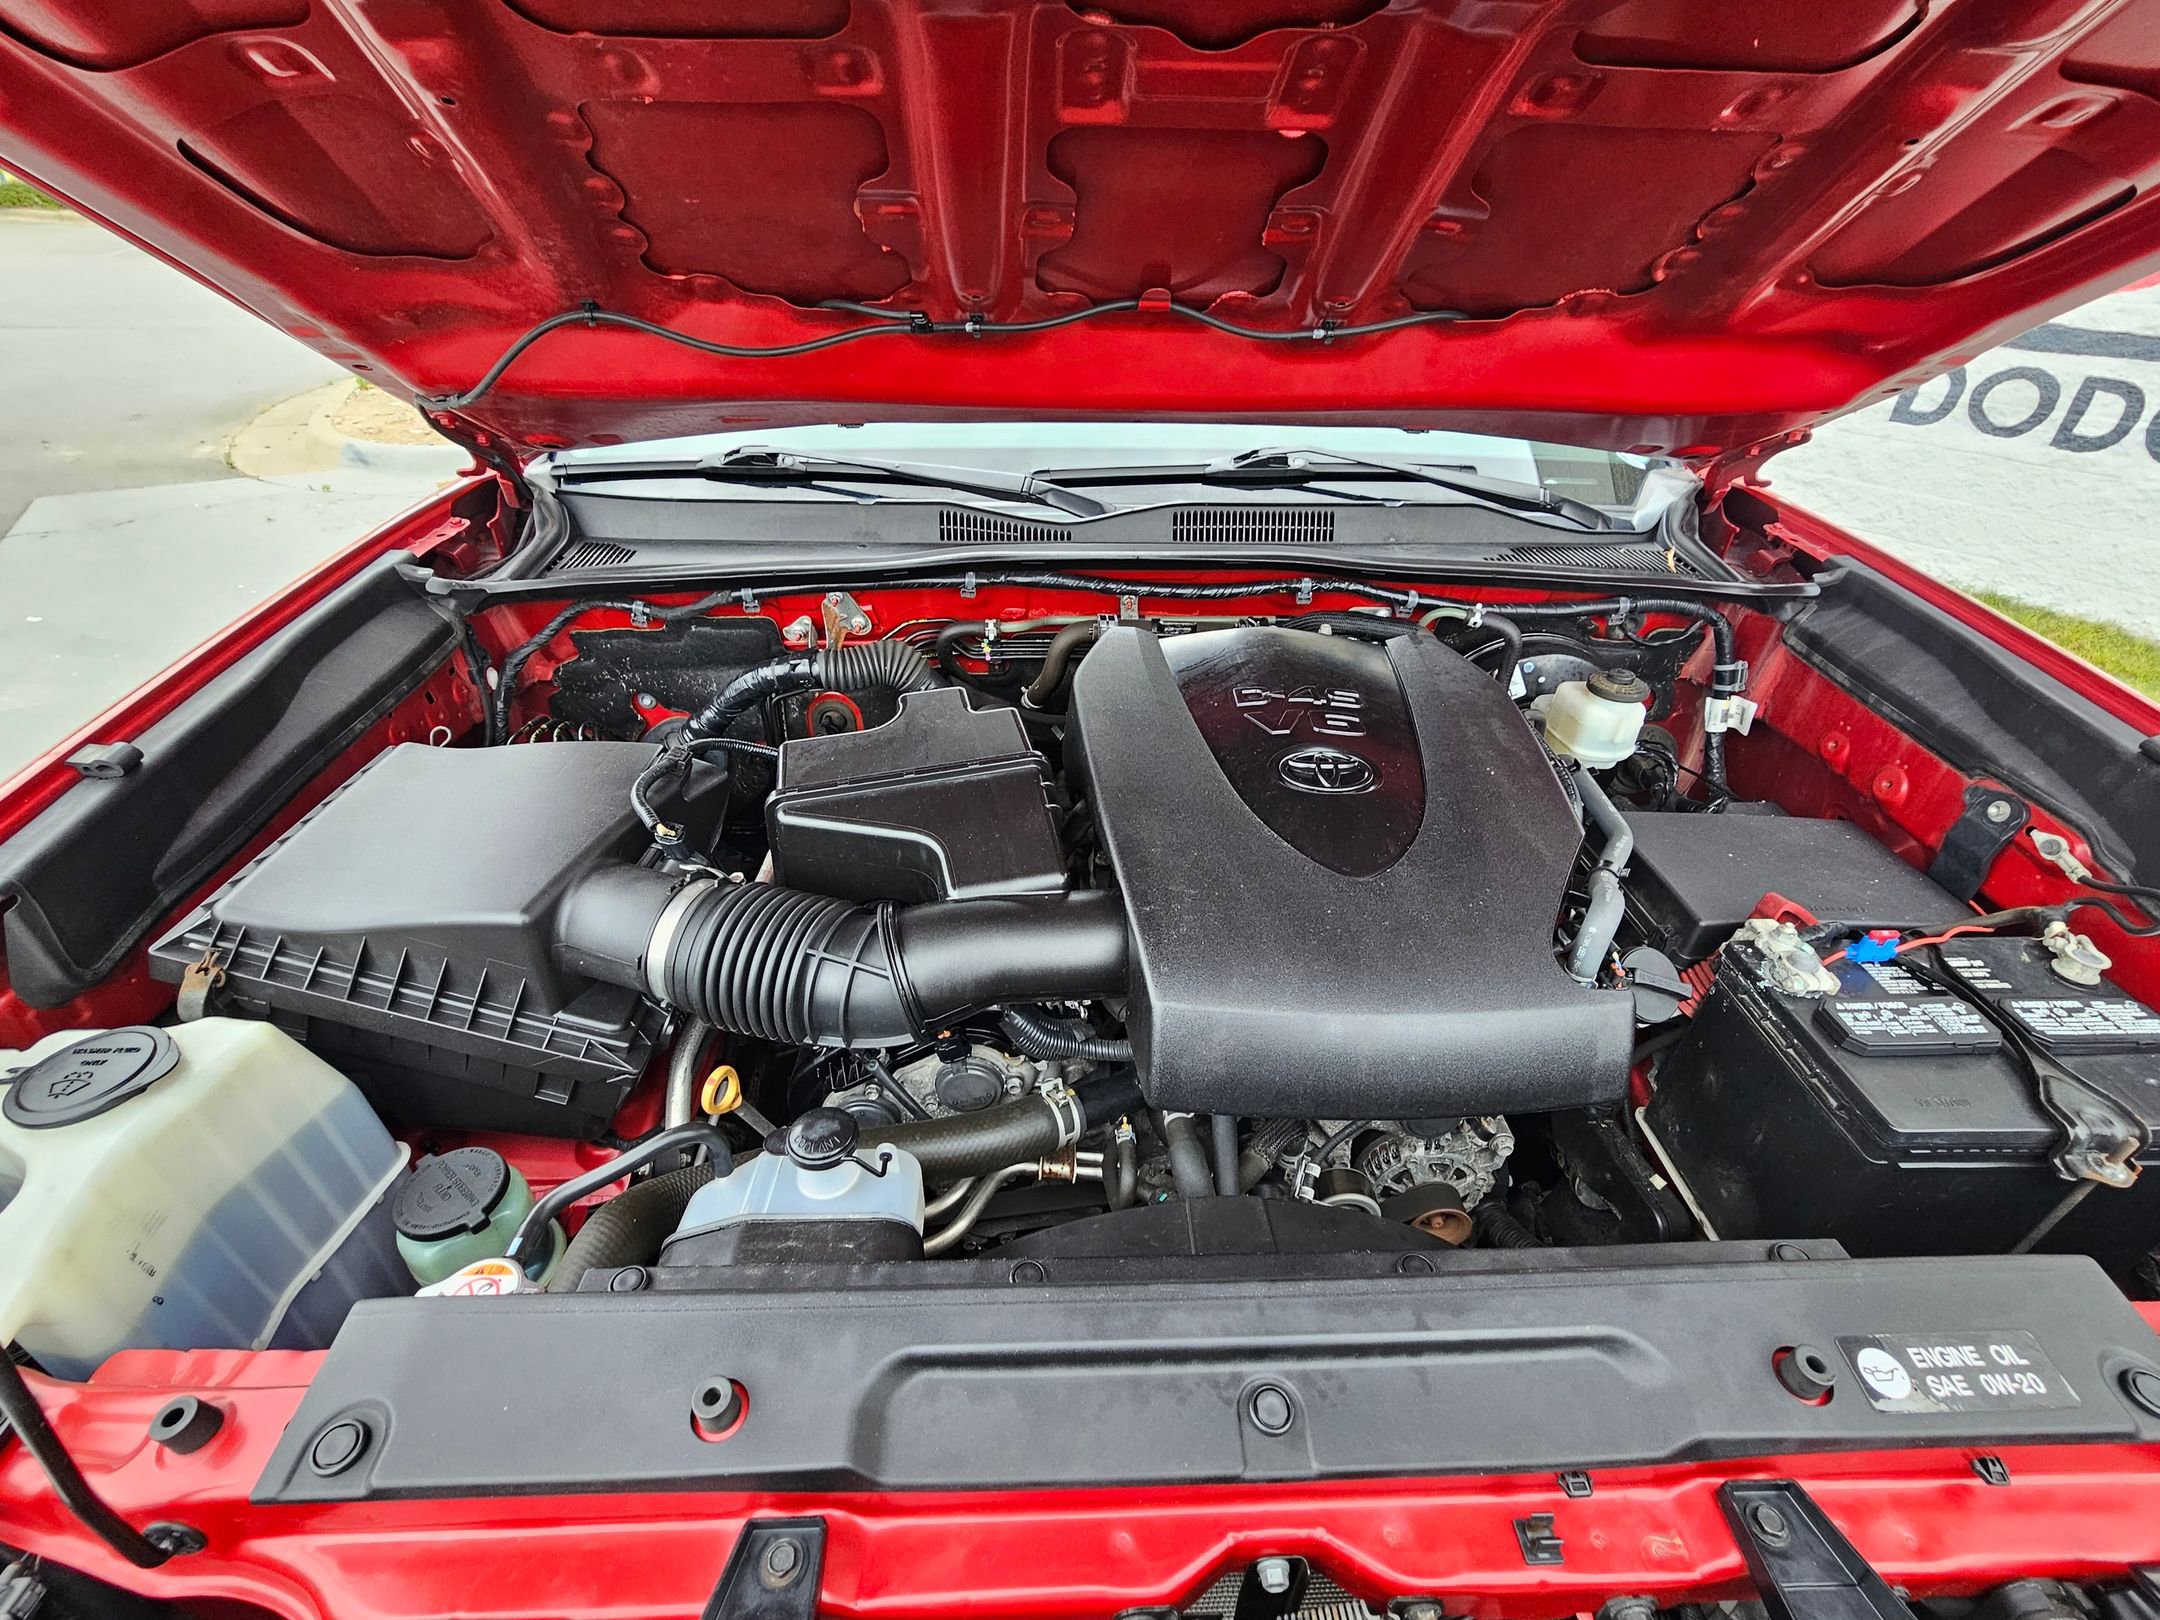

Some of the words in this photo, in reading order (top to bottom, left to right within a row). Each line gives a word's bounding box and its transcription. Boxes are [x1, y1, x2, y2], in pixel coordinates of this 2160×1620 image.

[1889, 366, 2160, 464] DOD
[1233, 685, 1363, 708] D-4S
[1243, 709, 1367, 736] V6
[794, 1135, 841, 1153] COOLANT
[452, 1177, 480, 1208] STEERING
[1906, 1345, 1986, 1369] ENGINE
[1988, 1344, 2031, 1367] OIL
[1925, 1374, 1976, 1399] SAE
[1979, 1372, 2048, 1396] 0W-20
